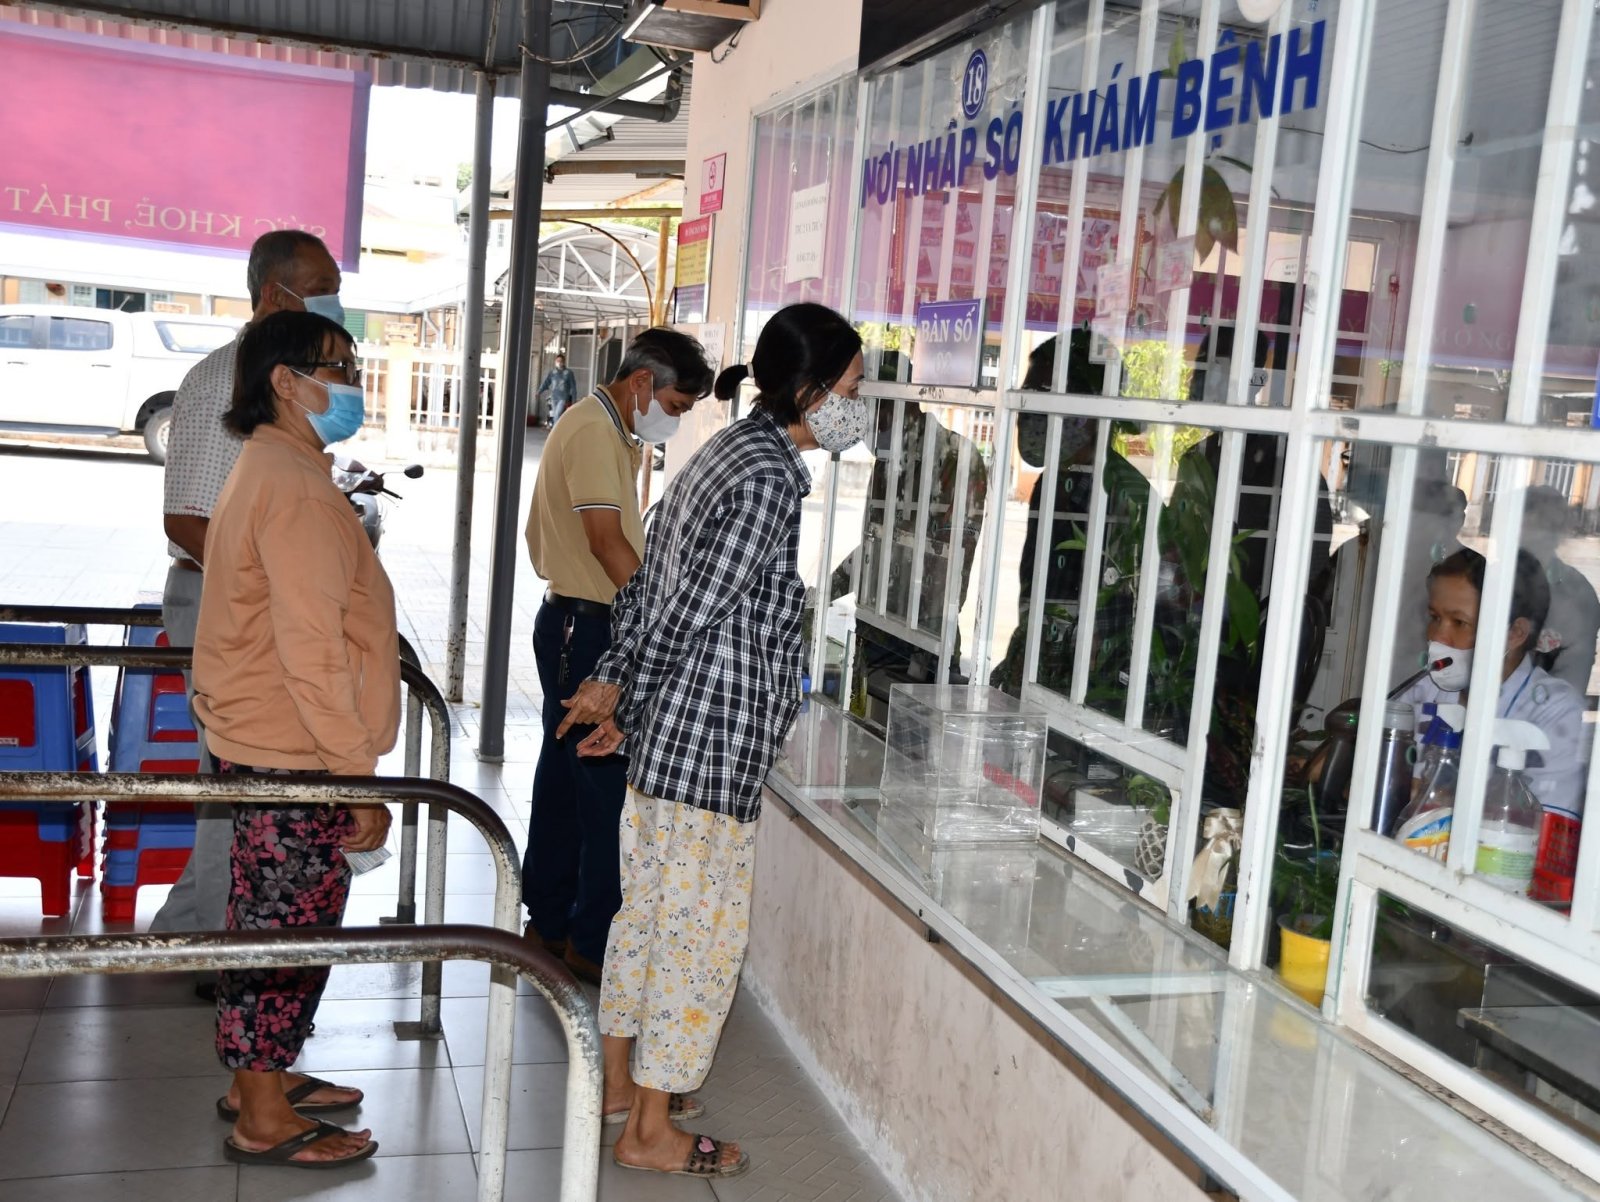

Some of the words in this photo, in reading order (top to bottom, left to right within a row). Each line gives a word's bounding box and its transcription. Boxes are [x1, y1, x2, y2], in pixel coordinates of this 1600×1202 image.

[965, 64, 984, 107] 18
[861, 140, 900, 208] NƠI
[904, 118, 977, 206] NHẬP
[1042, 62, 1160, 165] KHÁM
[1171, 20, 1326, 152] BỆNH
[920, 312, 951, 343] BÀN
[953, 305, 976, 343] SỐ
